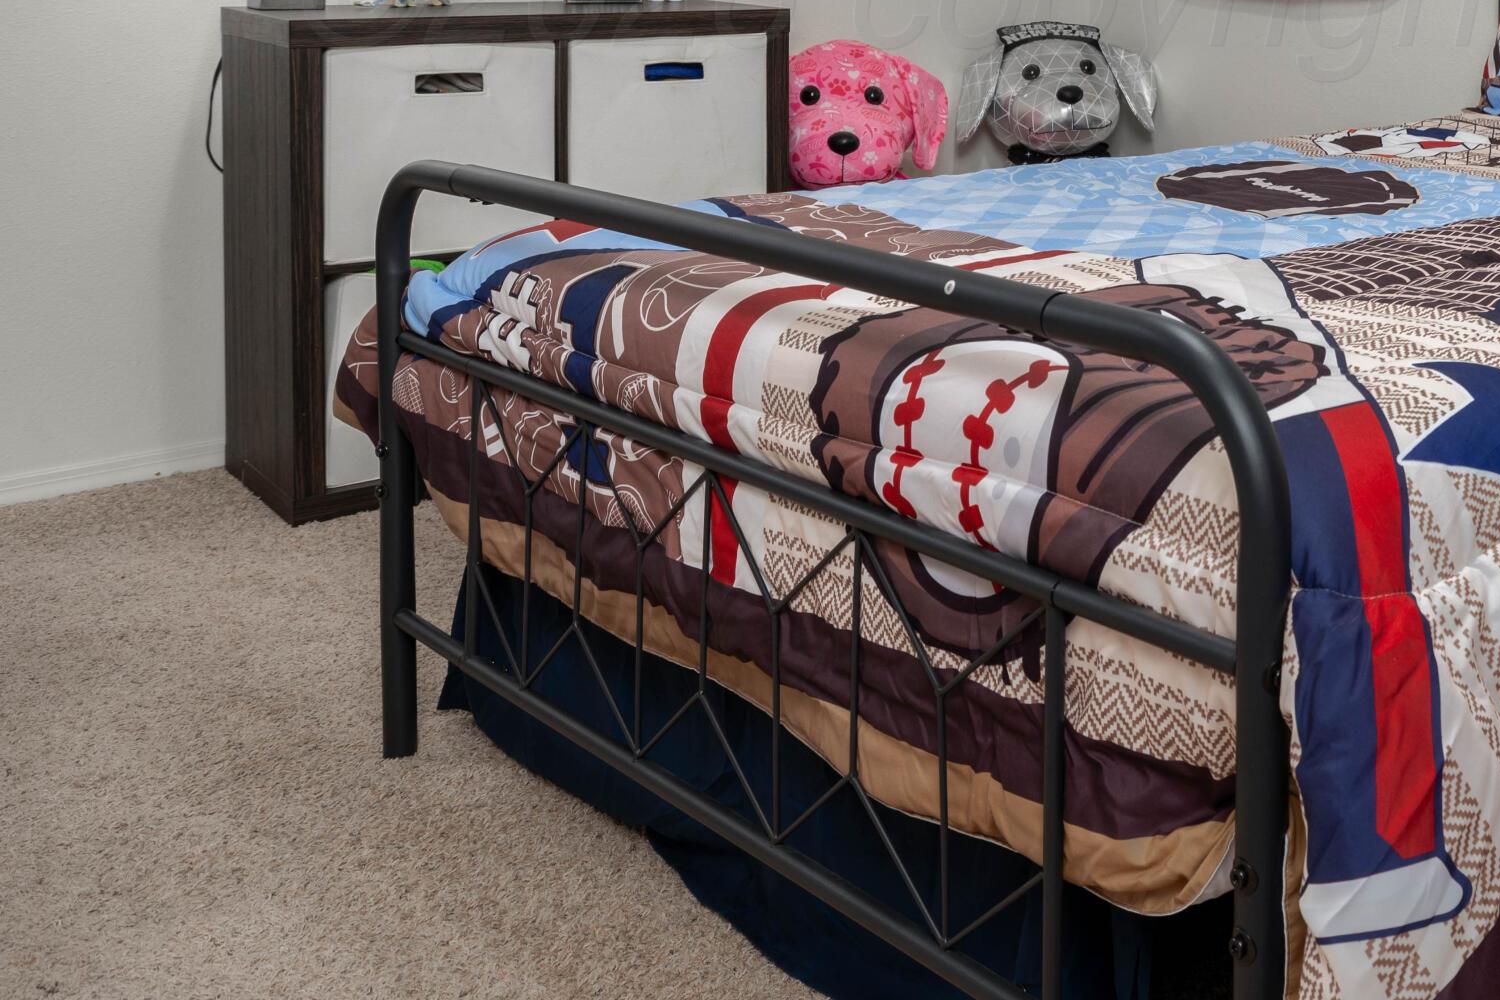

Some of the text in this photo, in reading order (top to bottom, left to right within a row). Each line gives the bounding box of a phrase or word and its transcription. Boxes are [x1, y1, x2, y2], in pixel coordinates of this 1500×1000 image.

[1020, 22, 1080, 33] HAPPY
[1001, 29, 1100, 45] NEW YEAR
